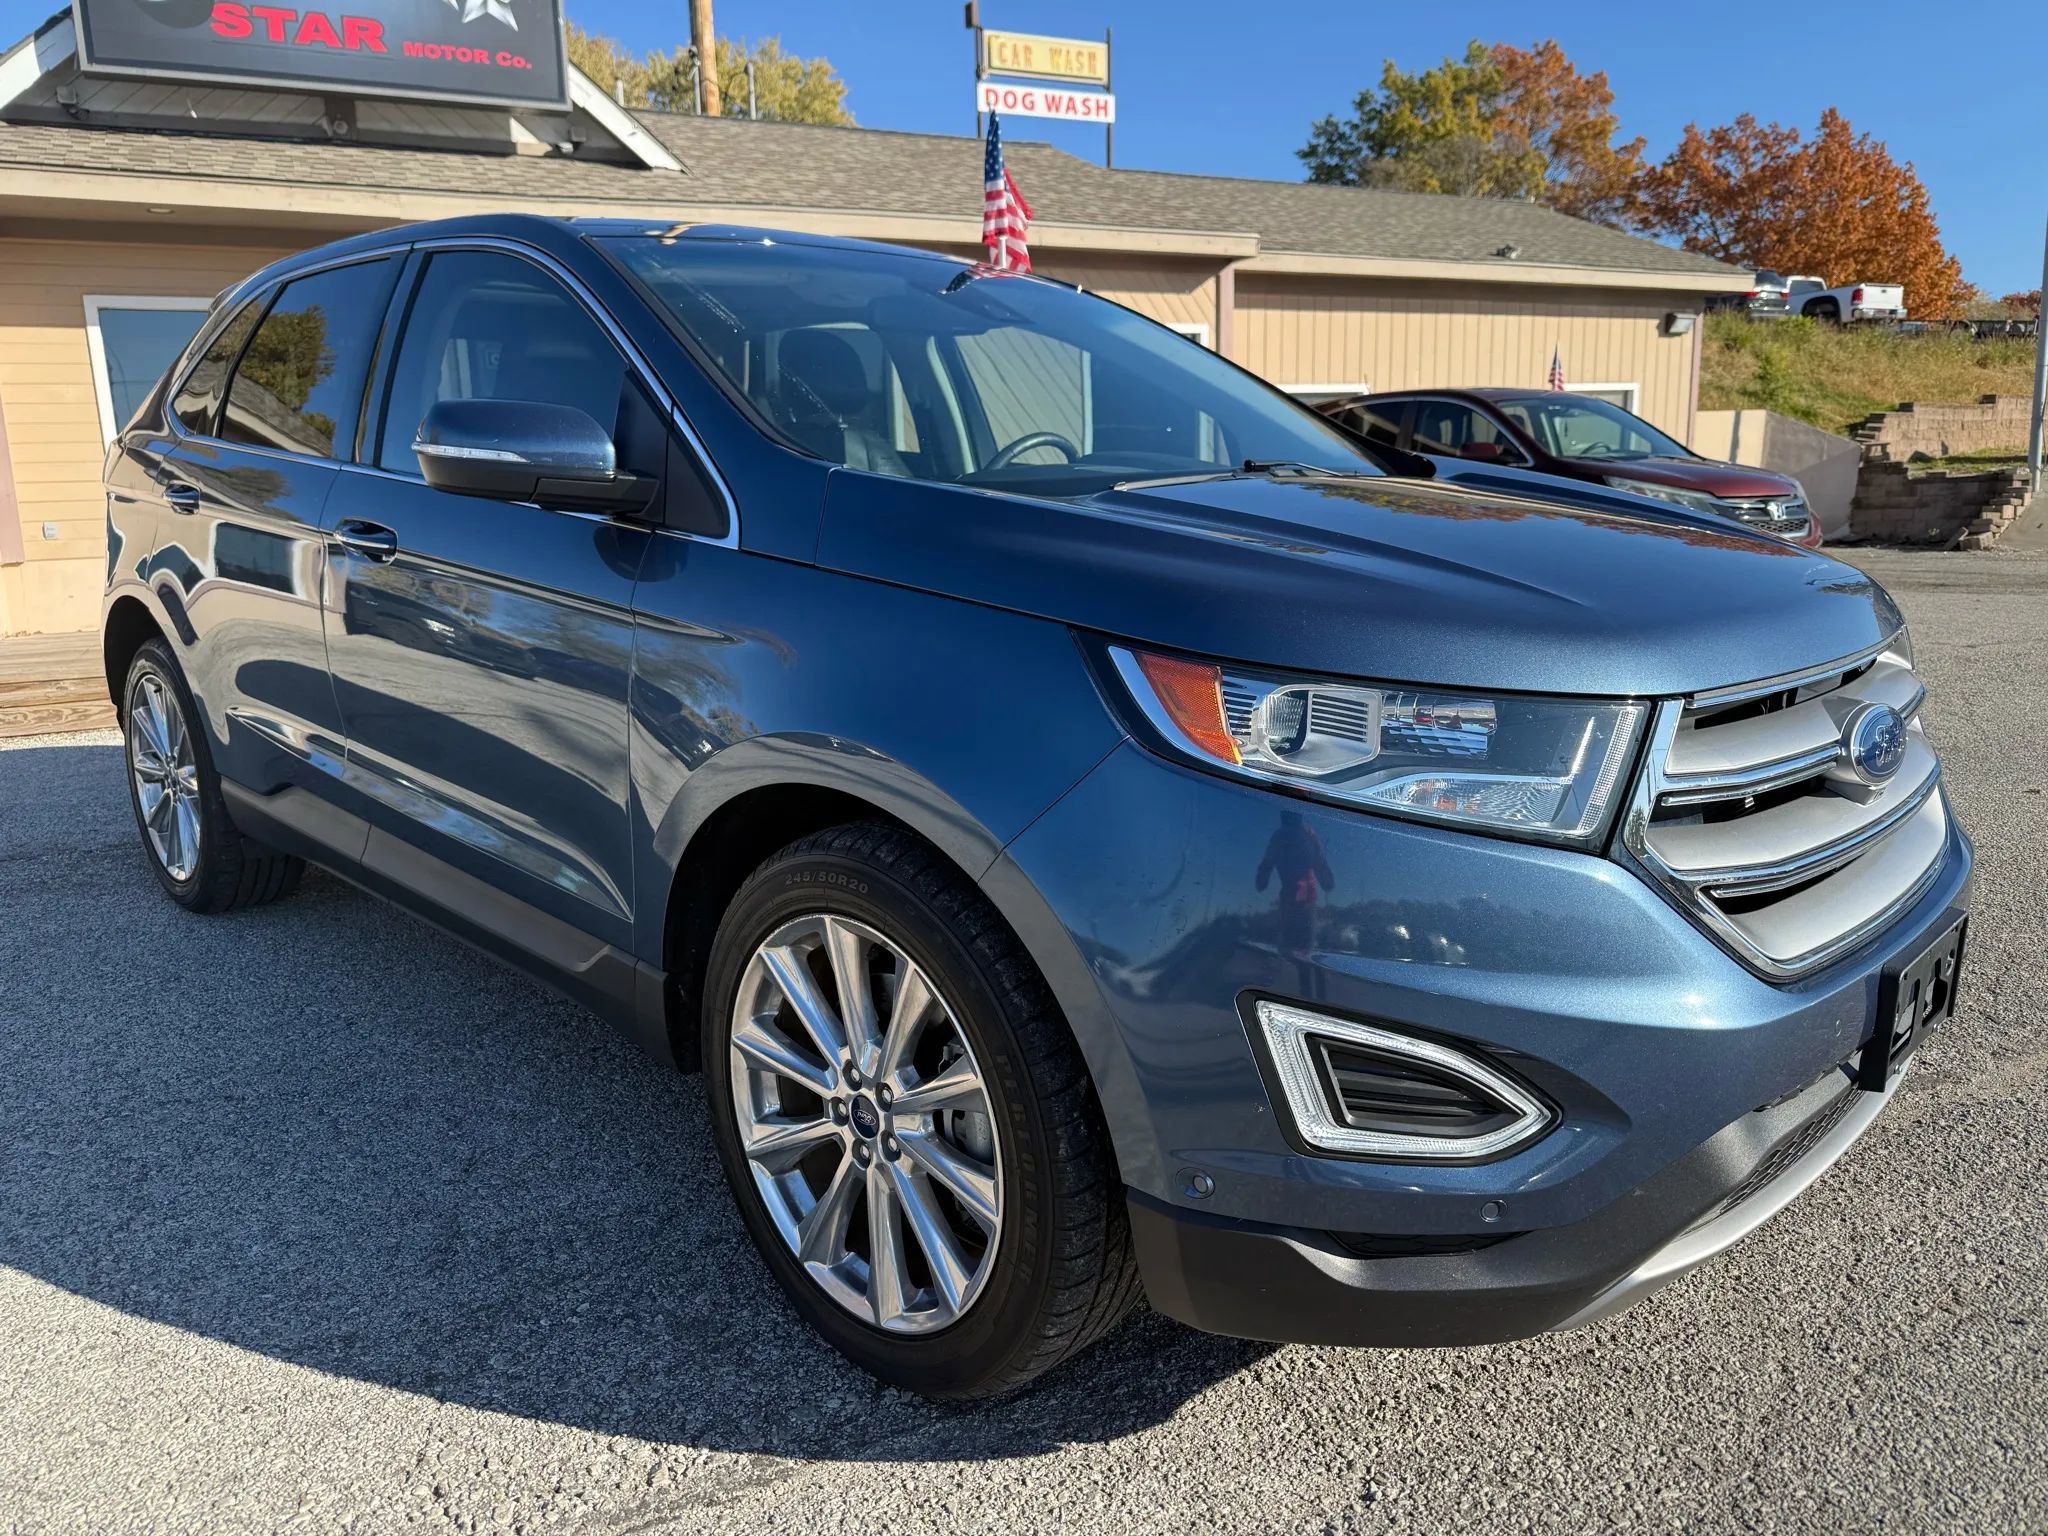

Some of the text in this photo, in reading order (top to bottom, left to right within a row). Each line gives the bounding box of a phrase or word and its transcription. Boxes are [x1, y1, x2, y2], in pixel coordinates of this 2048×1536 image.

[209, 1, 533, 70] STAR MOTOR Co.
[997, 42, 1098, 75] CAR WASH
[985, 87, 1109, 118] DOG WASH
[784, 870, 870, 895] 245/50R20
